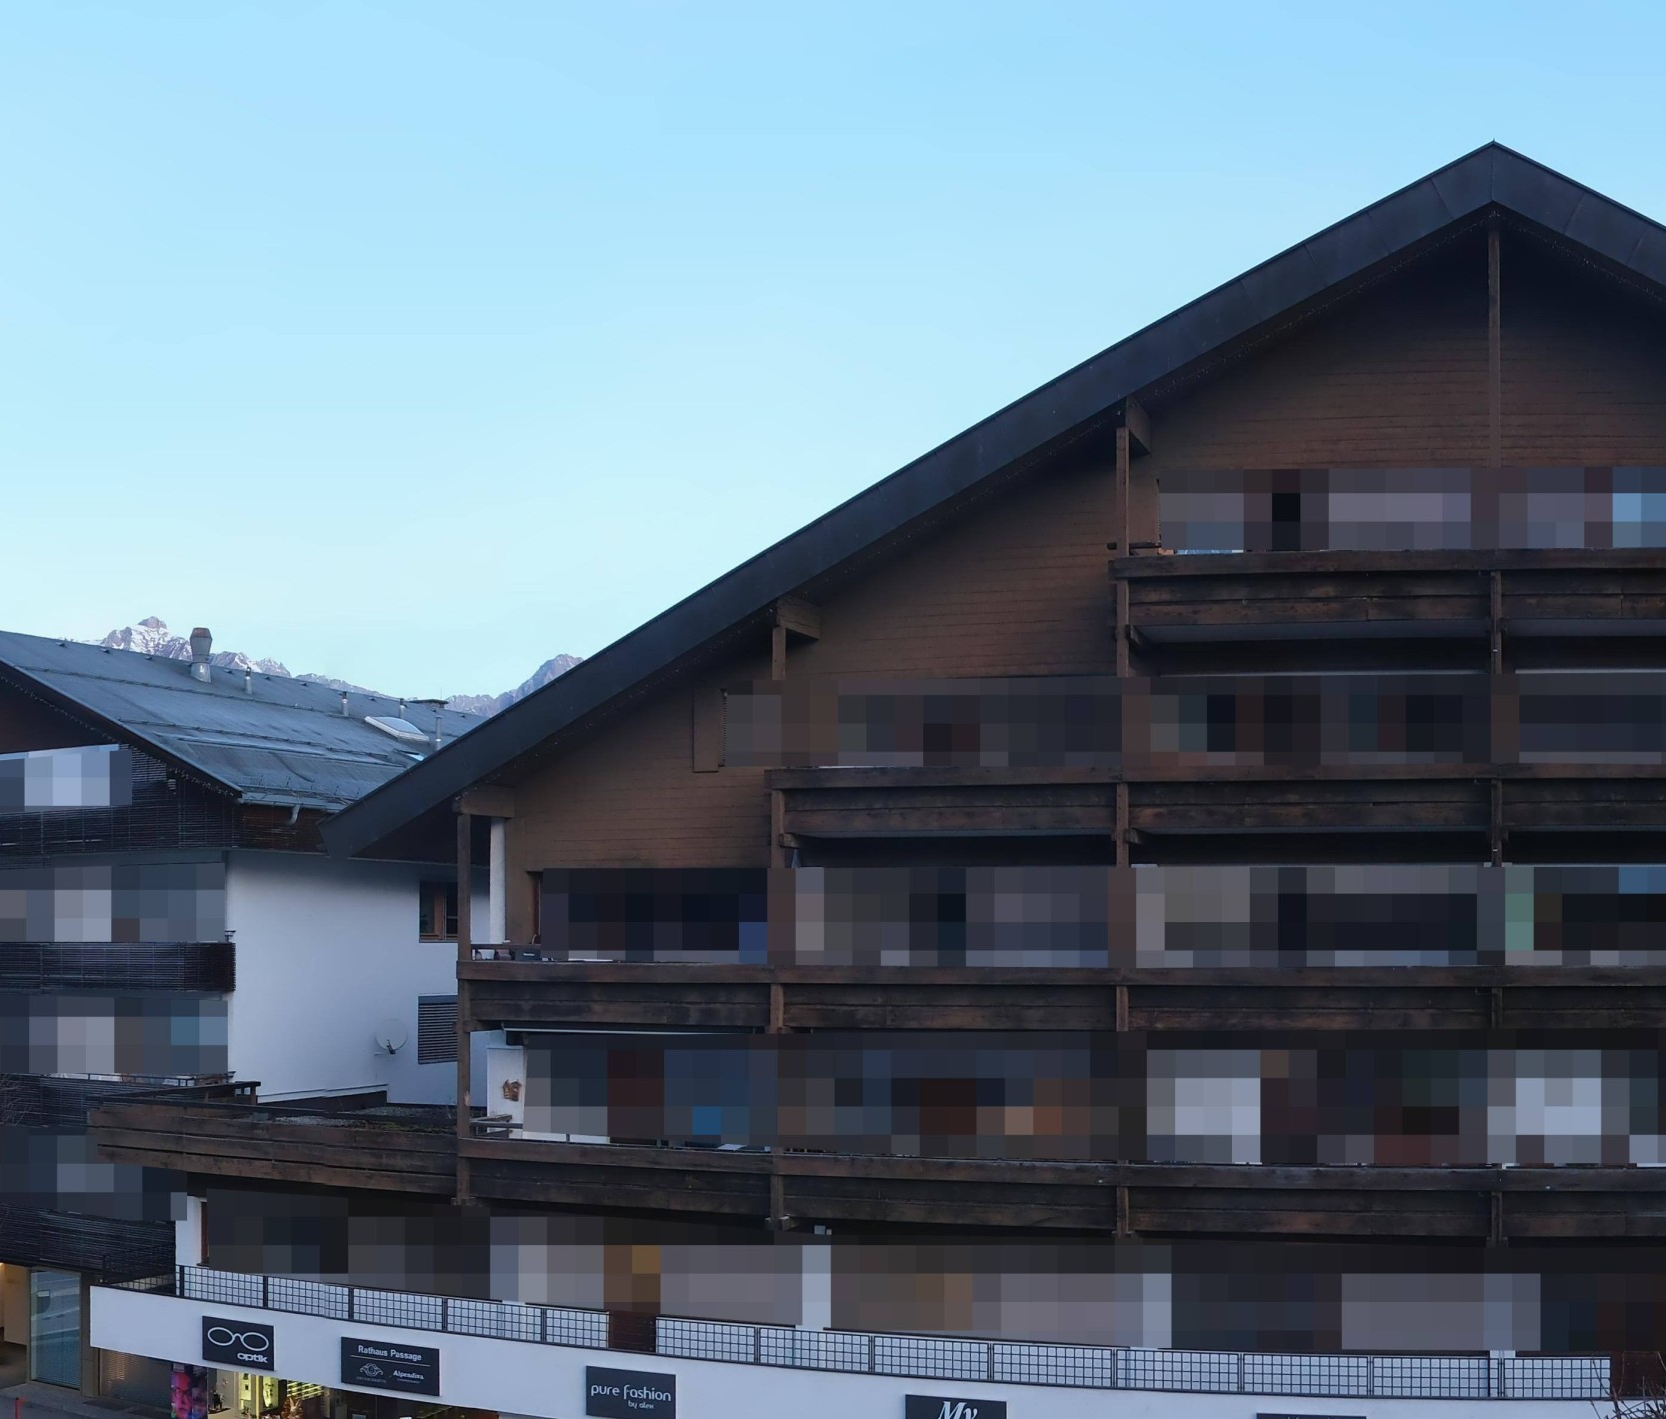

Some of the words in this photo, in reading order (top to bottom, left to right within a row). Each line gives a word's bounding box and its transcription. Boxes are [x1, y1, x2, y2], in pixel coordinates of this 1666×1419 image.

[236, 1351, 269, 1365] optik
[358, 1344, 388, 1357] Rathaus
[390, 1349, 422, 1362] Passage
[590, 1384, 621, 1397] pure
[623, 1384, 672, 1402] fashion
[627, 1400, 637, 1410] by
[638, 1401, 655, 1410] alex
